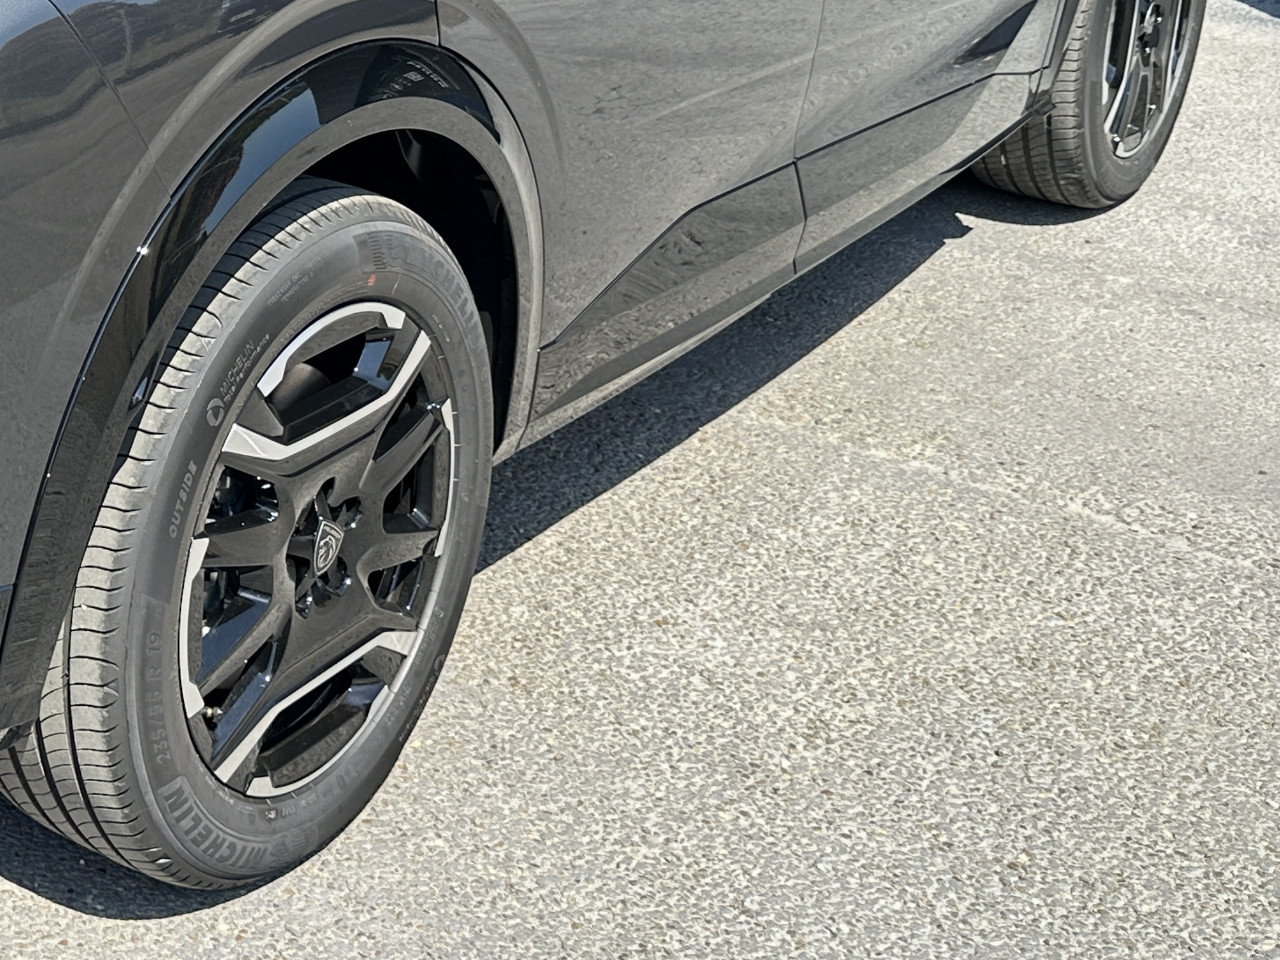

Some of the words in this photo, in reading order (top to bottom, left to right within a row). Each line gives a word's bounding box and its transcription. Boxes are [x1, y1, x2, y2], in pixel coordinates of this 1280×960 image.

[221, 340, 255, 396] MICHELIN
[169, 459, 198, 539] OUTSIDE
[164, 785, 269, 869] MICHELIN
